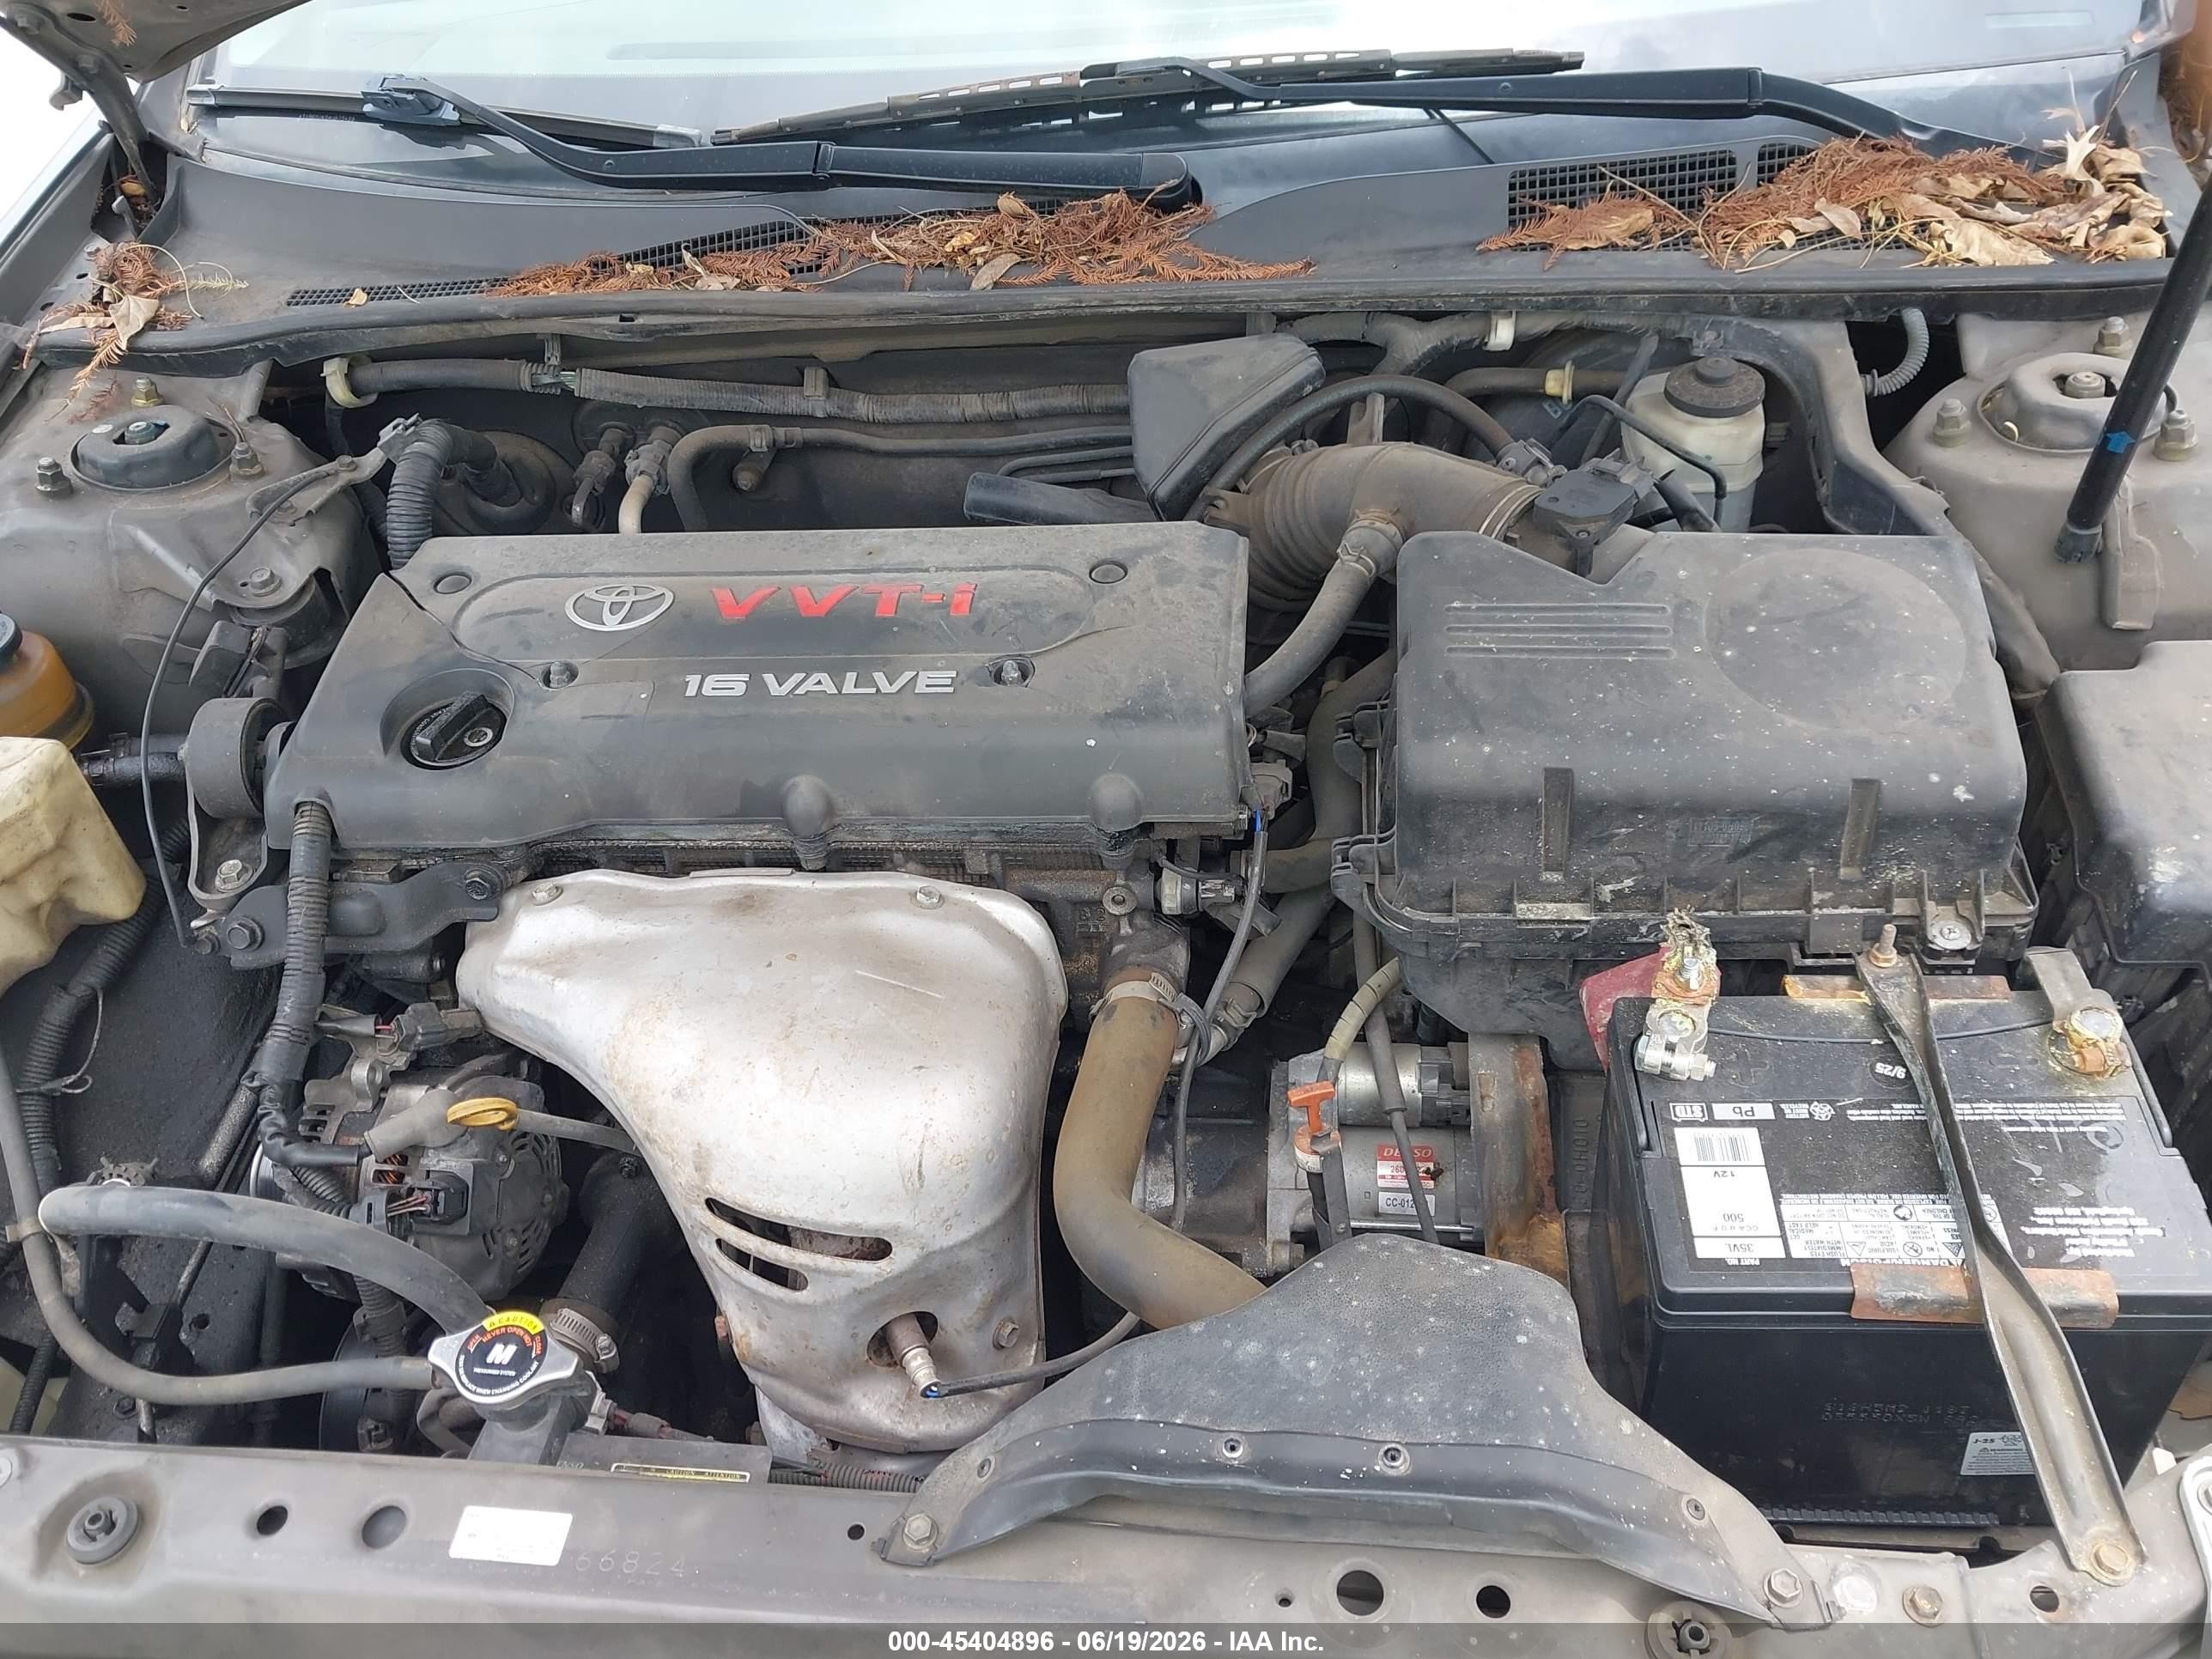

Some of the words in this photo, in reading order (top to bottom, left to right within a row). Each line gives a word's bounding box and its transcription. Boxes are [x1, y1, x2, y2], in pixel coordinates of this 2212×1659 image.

[710, 583, 978, 618] VVT-i
[684, 673, 750, 697] 16
[762, 670, 957, 696] VALVE
[1875, 1062, 1907, 1079] 9/25
[1732, 1106, 1755, 1117] Pb
[1383, 1147, 1432, 1158] DESO
[1385, 1197, 1415, 1209] CC-012
[1723, 1213, 1744, 1223] 500
[1725, 1243, 1754, 1253] 35VL
[498, 1316, 538, 1330] CAUTION
[481, 1327, 506, 1343] NEVER
[507, 1327, 524, 1339] OPEN
[522, 1335, 532, 1347] HOT
[520, 1361, 539, 1383] COOLANT
[574, 1550, 685, 1577] 66824
